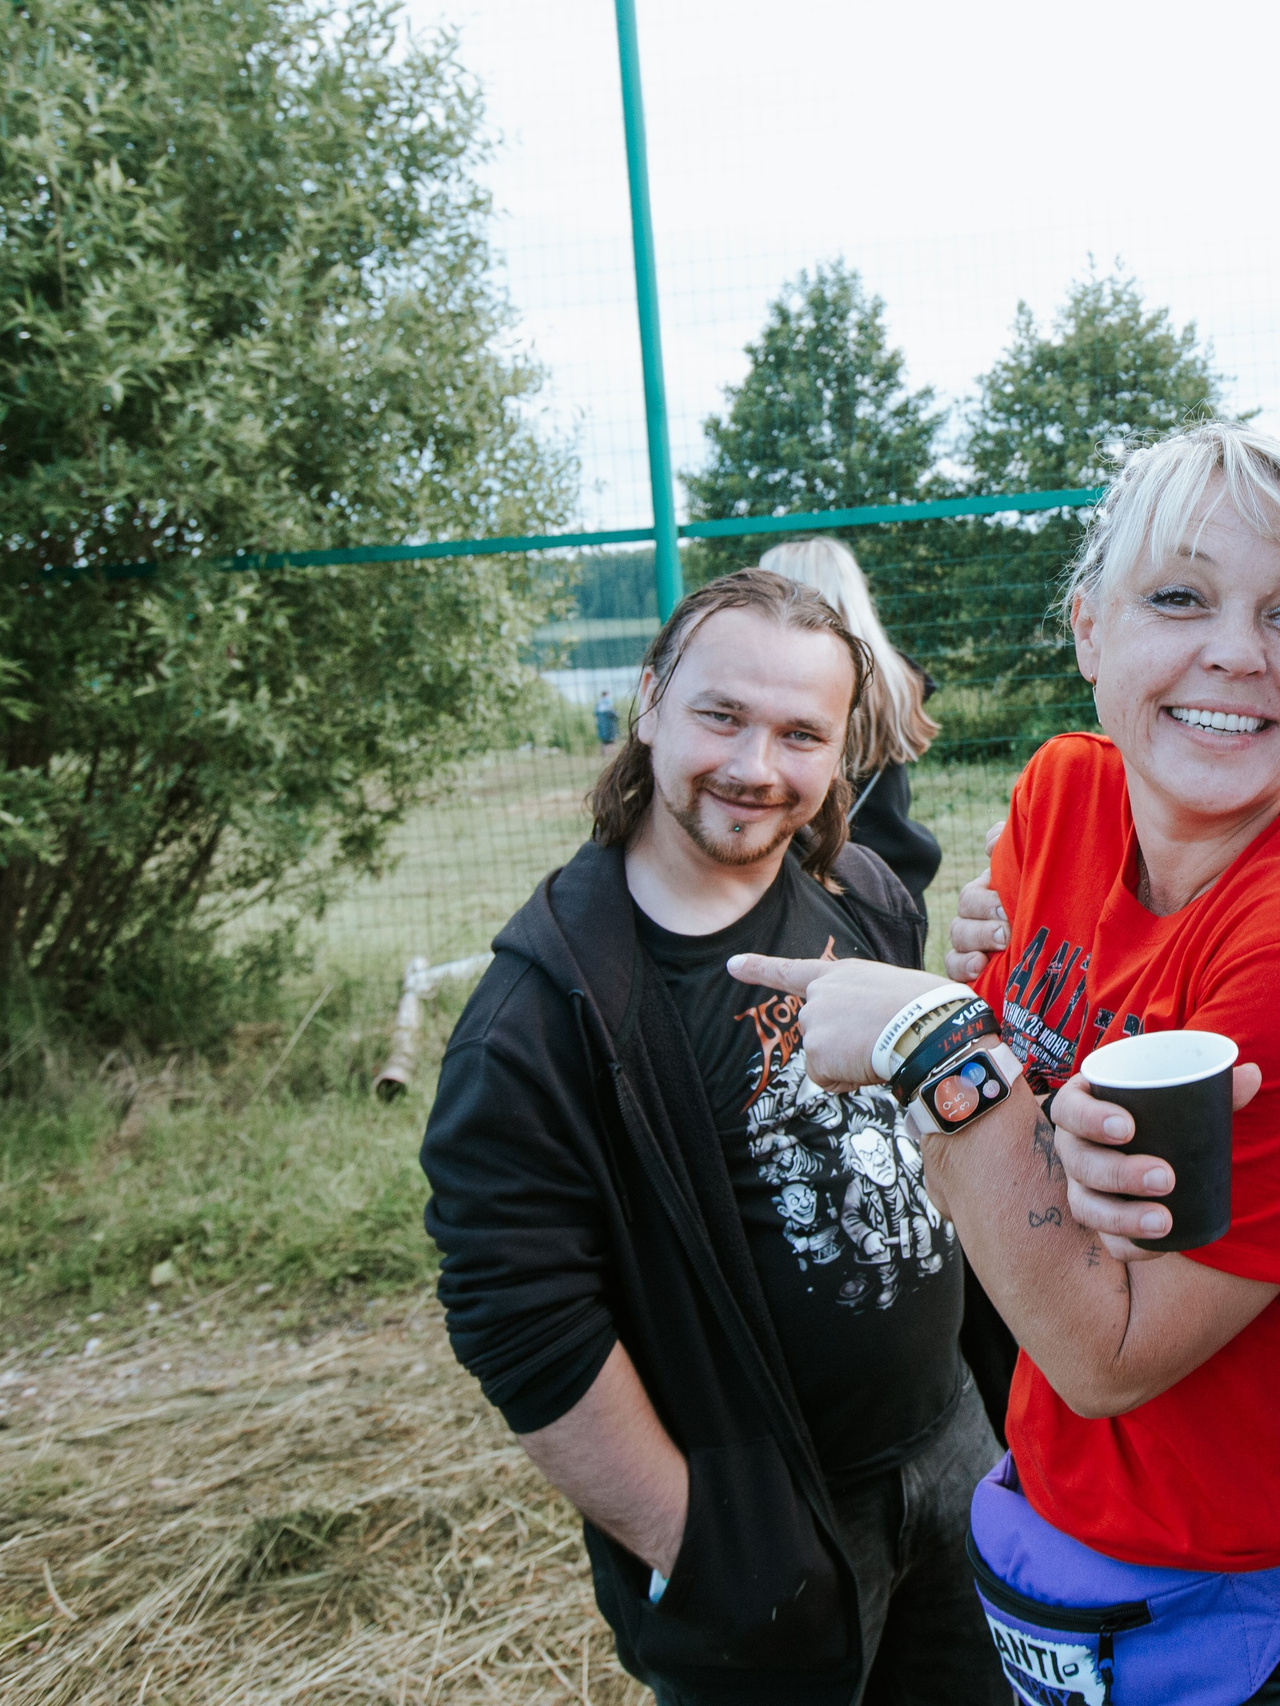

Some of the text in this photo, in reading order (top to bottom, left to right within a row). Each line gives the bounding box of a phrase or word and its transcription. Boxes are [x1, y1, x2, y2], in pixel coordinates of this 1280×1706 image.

[1003, 926, 1091, 1046] ANT
[1026, 1013, 1042, 1037] 26
[1038, 1028, 1069, 1059] ИЮНЯ
[943, 1101, 958, 1118] 19
[954, 1092, 971, 1111] 35
